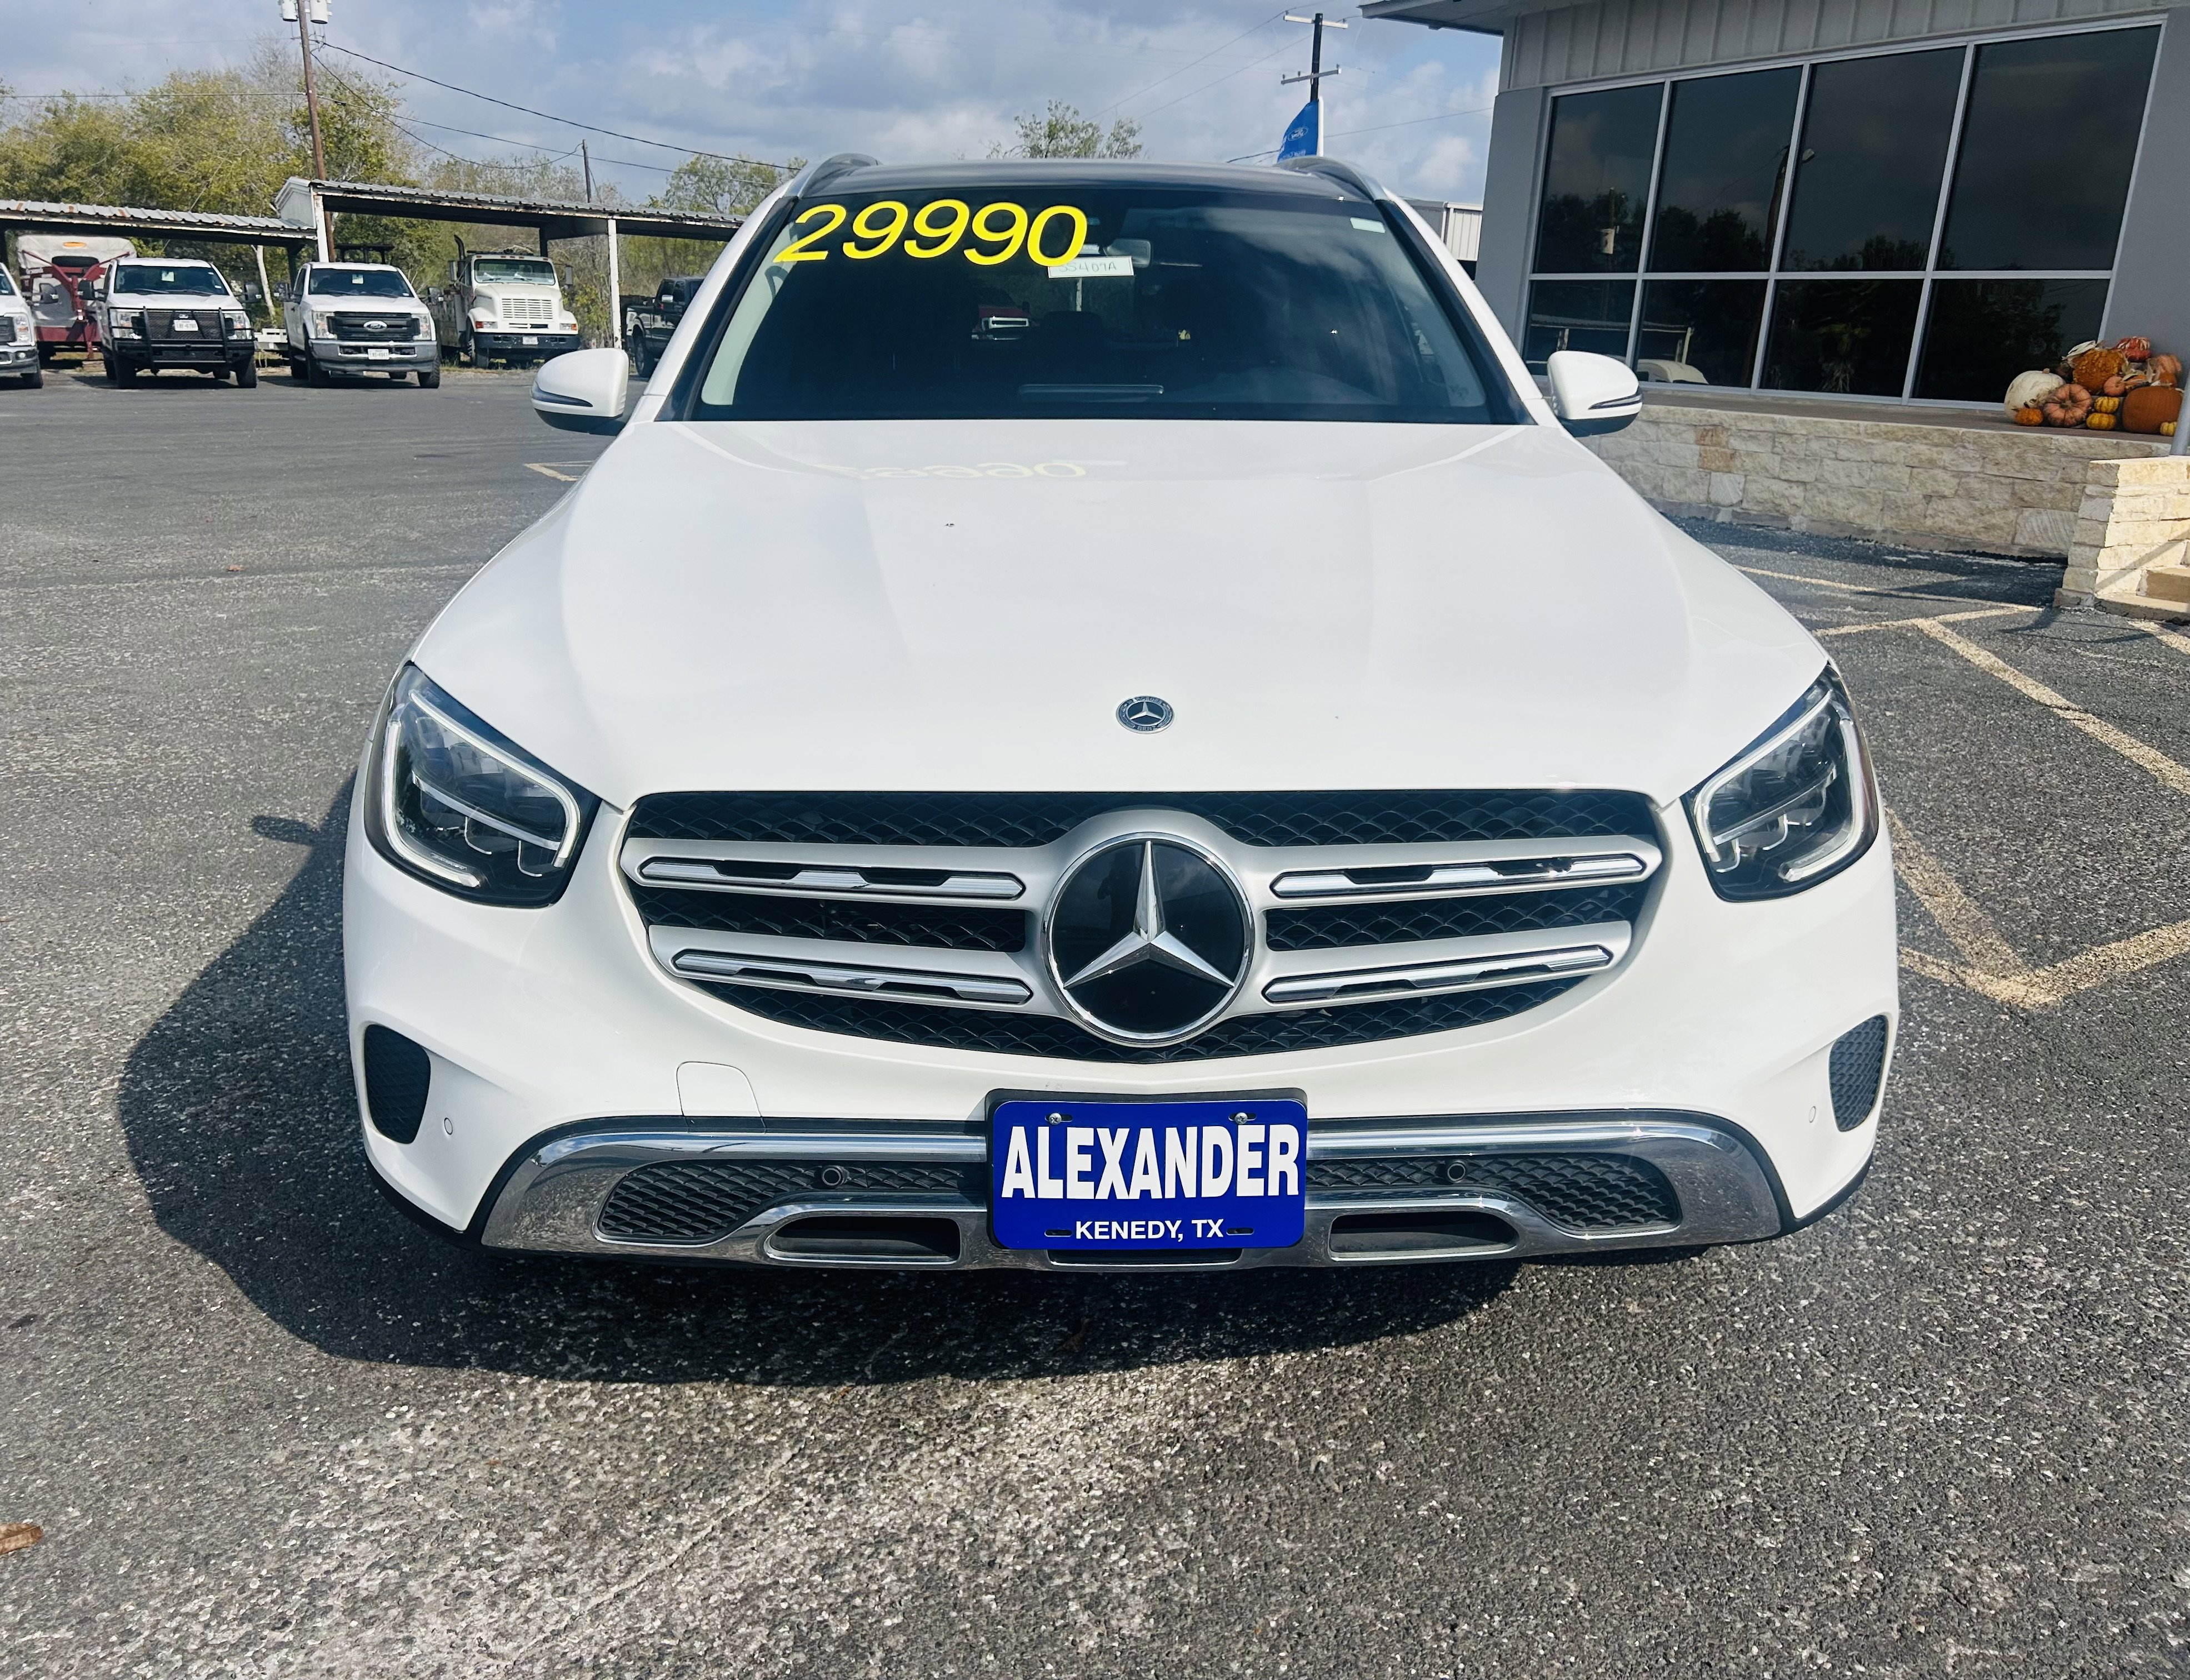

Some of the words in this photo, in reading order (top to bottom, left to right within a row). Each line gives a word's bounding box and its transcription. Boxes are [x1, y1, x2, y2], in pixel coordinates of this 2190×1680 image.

[772, 199, 1087, 267] 29990
[1001, 1124, 1300, 1200] ALEXANDER
[1076, 1220, 1183, 1242] KENEDY,
[1192, 1219, 1224, 1238] TX
